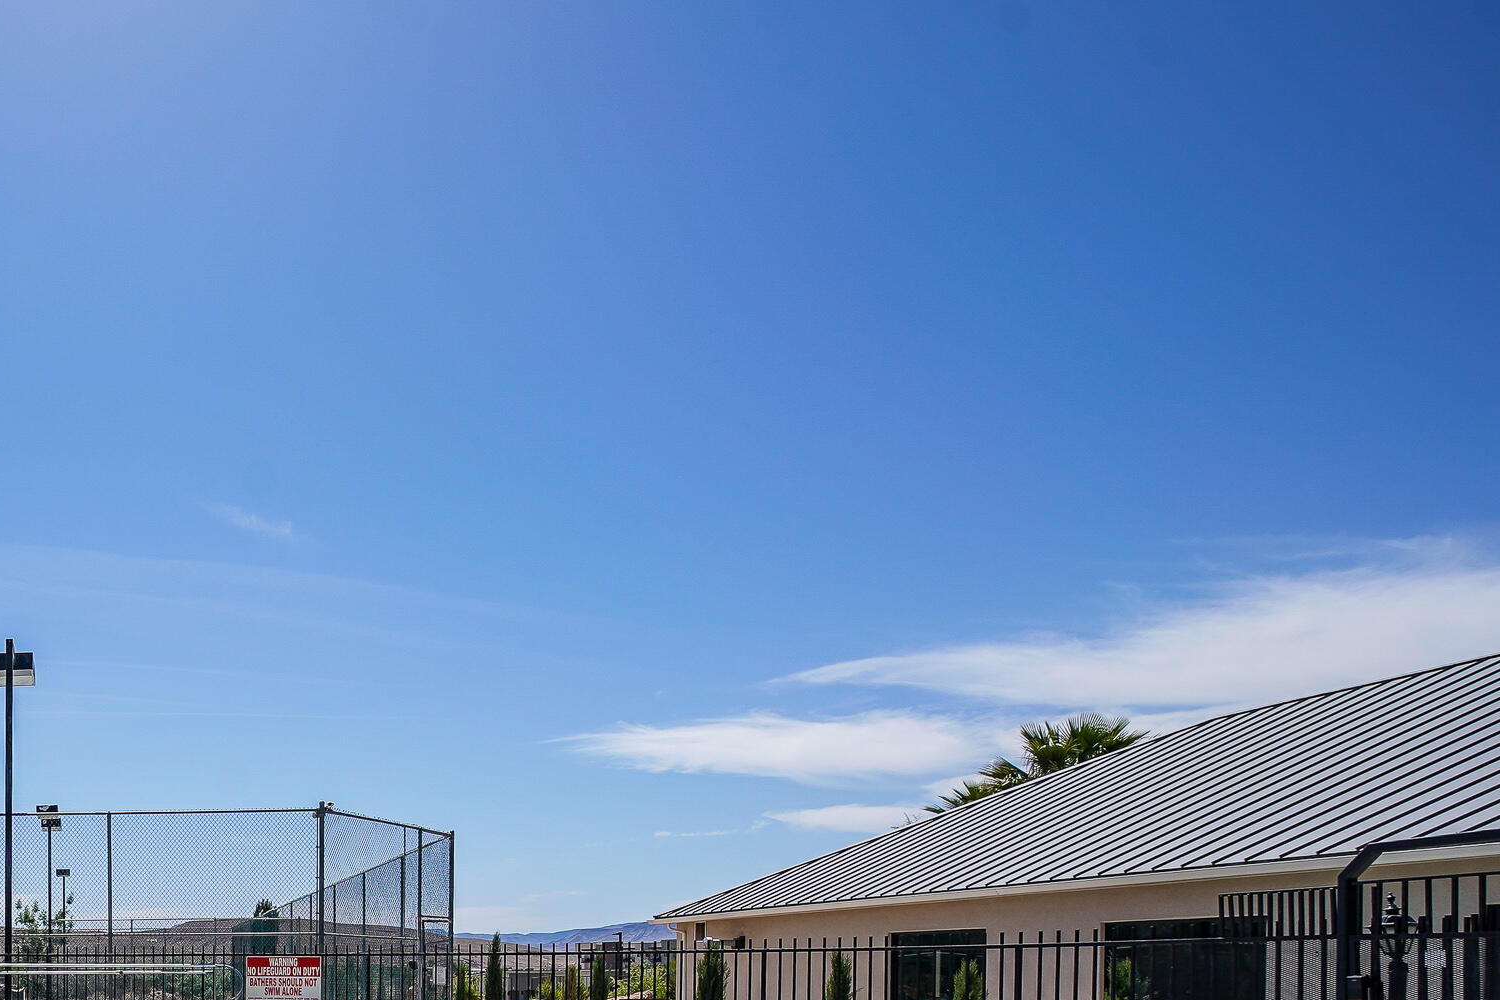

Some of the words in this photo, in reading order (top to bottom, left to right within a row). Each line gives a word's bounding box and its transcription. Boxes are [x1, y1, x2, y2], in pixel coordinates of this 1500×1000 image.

[269, 957, 298, 967] WARNING
[248, 967, 256, 976] NO
[258, 967, 291, 976] LIFEGUARD
[292, 967, 302, 976] ON
[303, 967, 320, 976] DUTY
[249, 978, 277, 987] BATHERS
[279, 978, 303, 987] SHOULD
[305, 978, 318, 987] NOT
[264, 987, 280, 996] SWIM
[282, 987, 302, 996] ALONE
